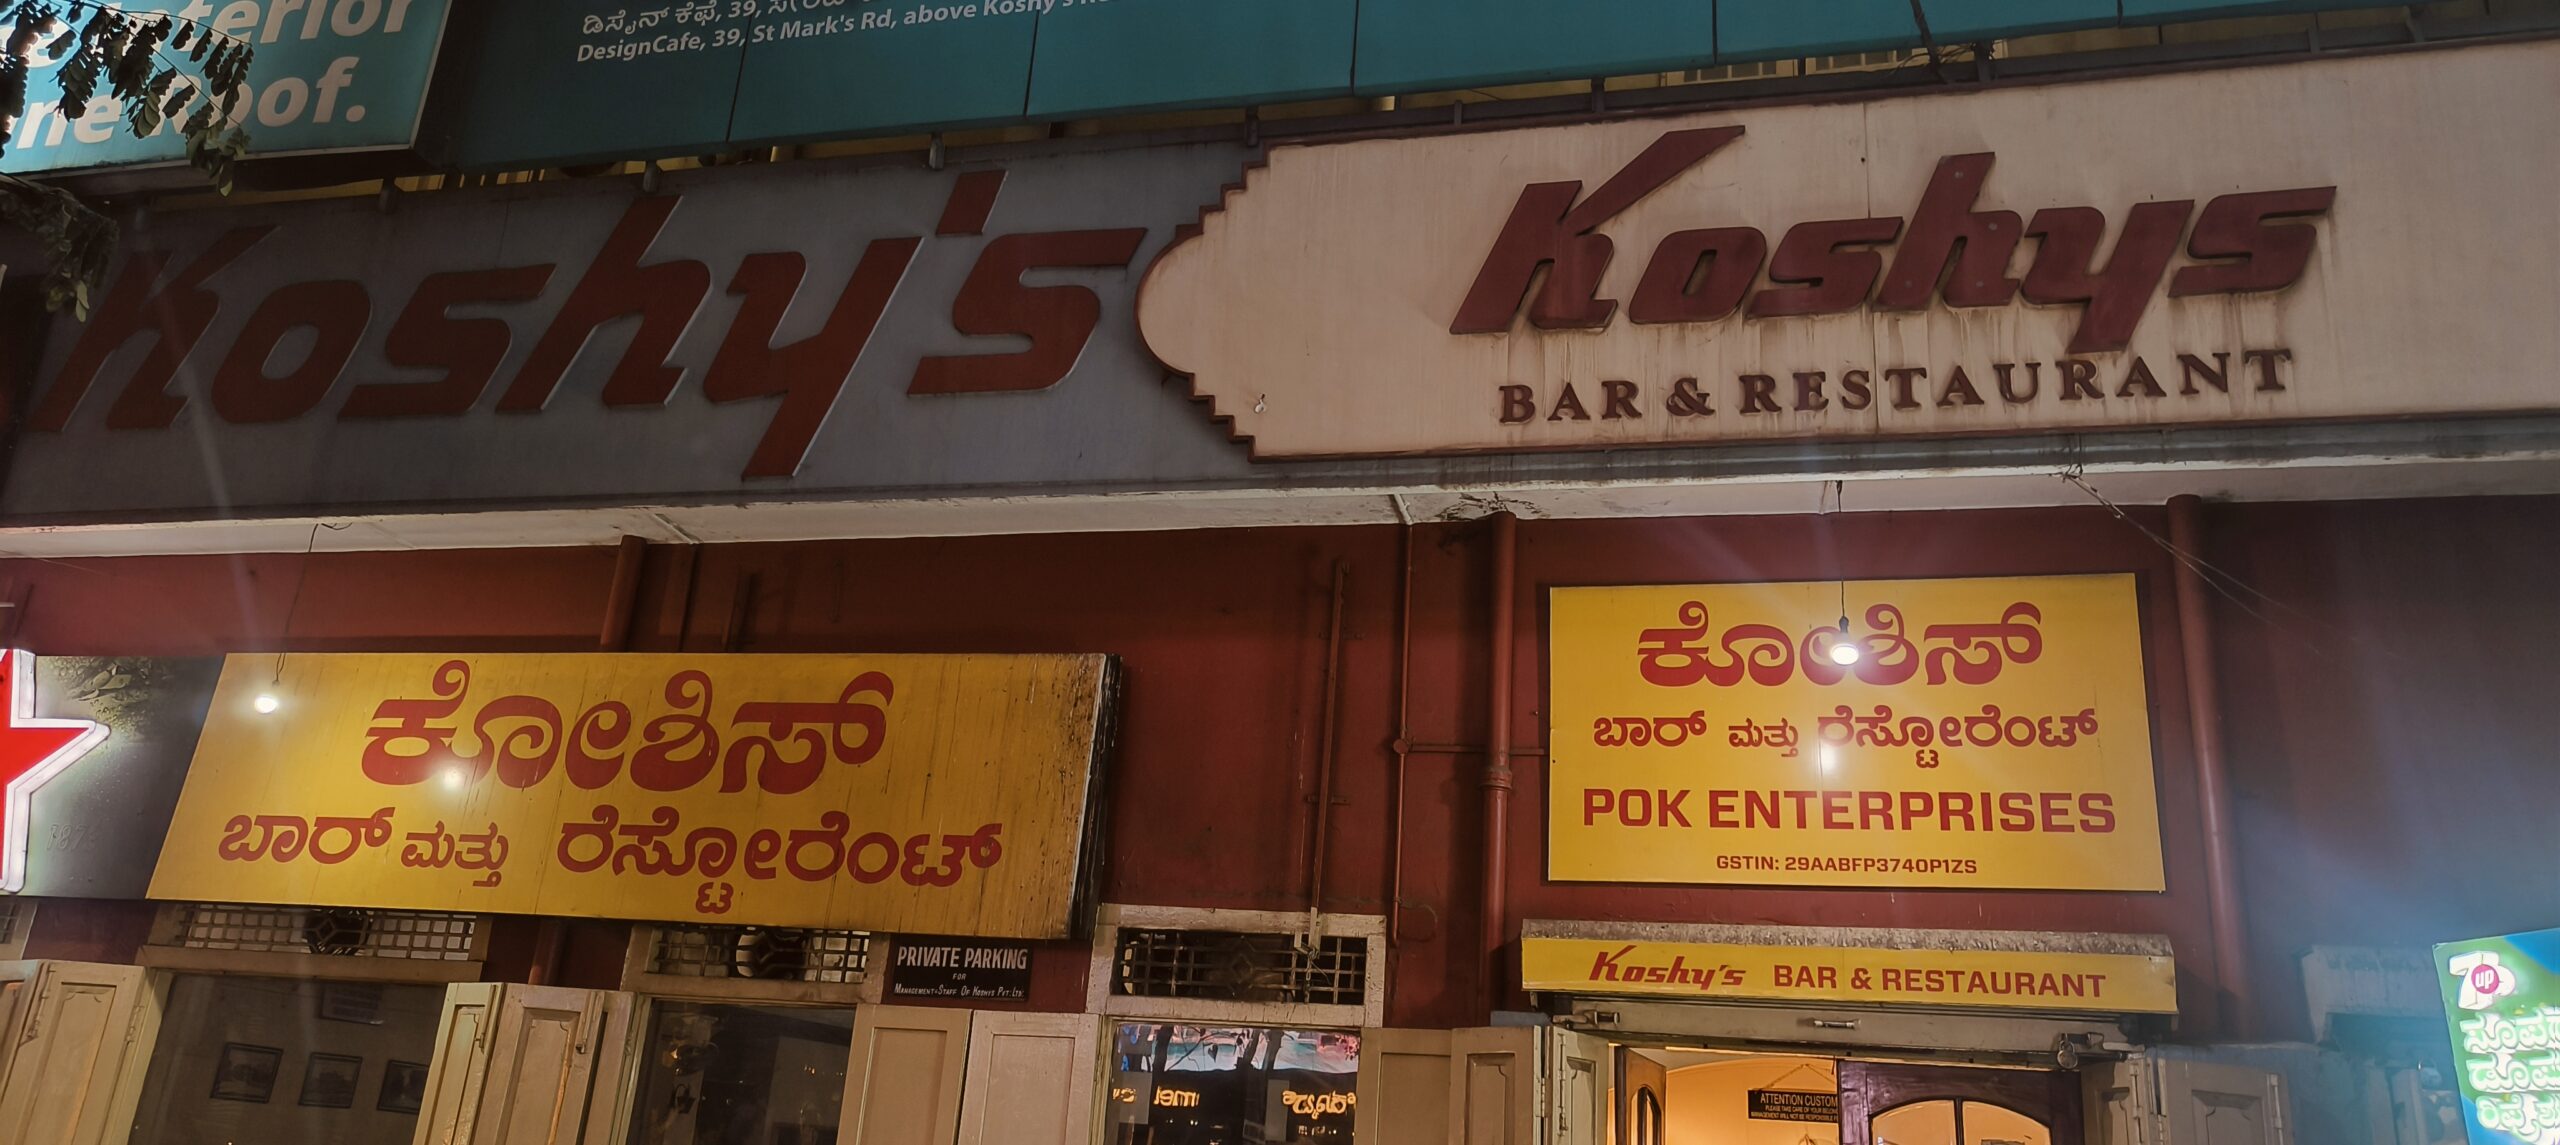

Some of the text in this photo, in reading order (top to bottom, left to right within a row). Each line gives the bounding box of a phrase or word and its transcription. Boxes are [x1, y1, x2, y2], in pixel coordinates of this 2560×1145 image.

[577, 33, 706, 62] DesignCafe,
[712, 28, 747, 48] 39,
[752, 25, 775, 43] St
[780, 14, 855, 41] Mark's
[861, 8, 897, 30] Rd,
[904, 2, 977, 25] above
[728, 0, 761, 19] 39,
[1450, 125, 2337, 353] Koshys
[28, 168, 1147, 480] Koshy's
[1499, 348, 2292, 424] BAR & RESTAURANT
[1637, 600, 2043, 688] ಕೋಶಿಸ್
[361, 659, 894, 794] ಕೋಶಿಸ್
[1593, 704, 2099, 769] ಬಾರ್ ಮತ್ತು ರೆಸ್ಟೋರೆಂಟ್
[1583, 788, 2116, 833] POK ENTERPRISES
[218, 804, 1004, 914] ಬಾರ್ ಮತ್ತು ರೆಸ್ಟೋರೆಂಟ್
[1716, 855, 1779, 870] GSTIN:
[897, 946, 1028, 970] PRIVATE PARKING
[952, 972, 967, 981] FOR
[1589, 944, 2106, 999] Koshy's BAR & RESTAURANT
[1760, 1093, 1803, 1105] ATTENTION
